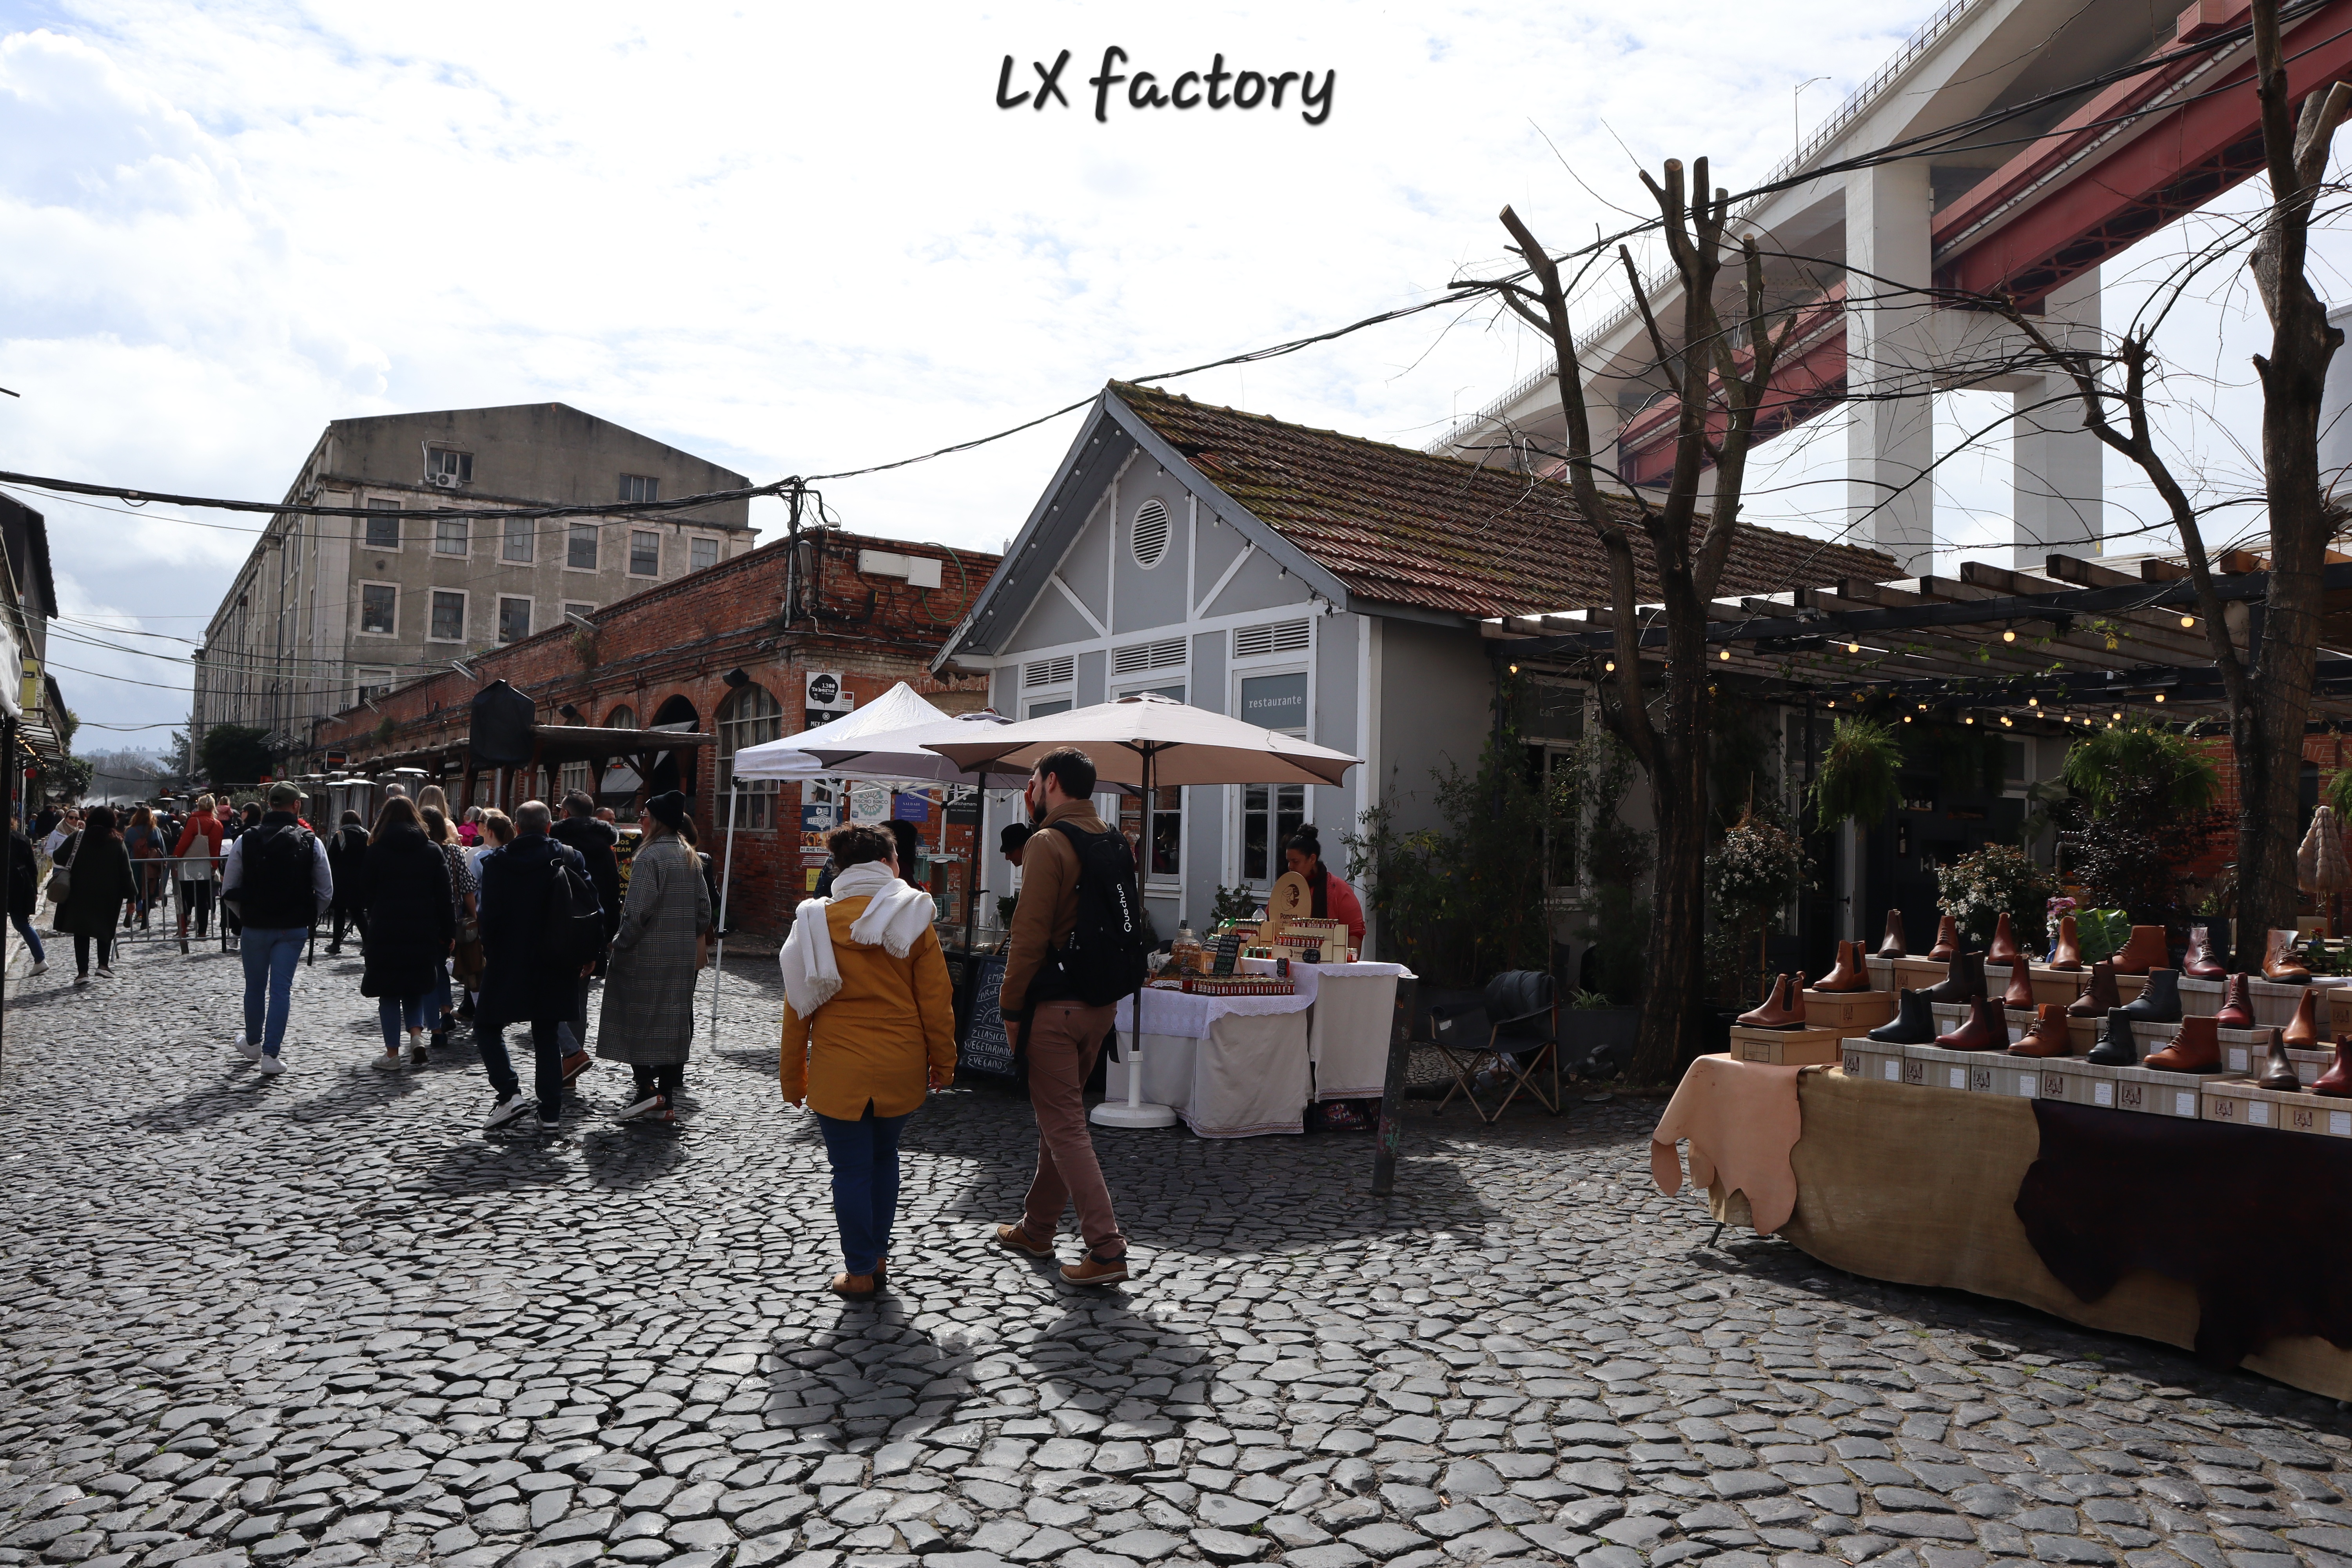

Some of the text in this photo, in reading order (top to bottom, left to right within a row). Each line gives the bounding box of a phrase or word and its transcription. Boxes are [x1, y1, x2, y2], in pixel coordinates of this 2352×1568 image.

[1249, 695, 1302, 708] restaurante
[1117, 884, 1132, 932] Quechua
[987, 973, 1004, 984] EMP
[980, 986, 1001, 1001] ARGE
[973, 1056, 1002, 1069] VEGANO
